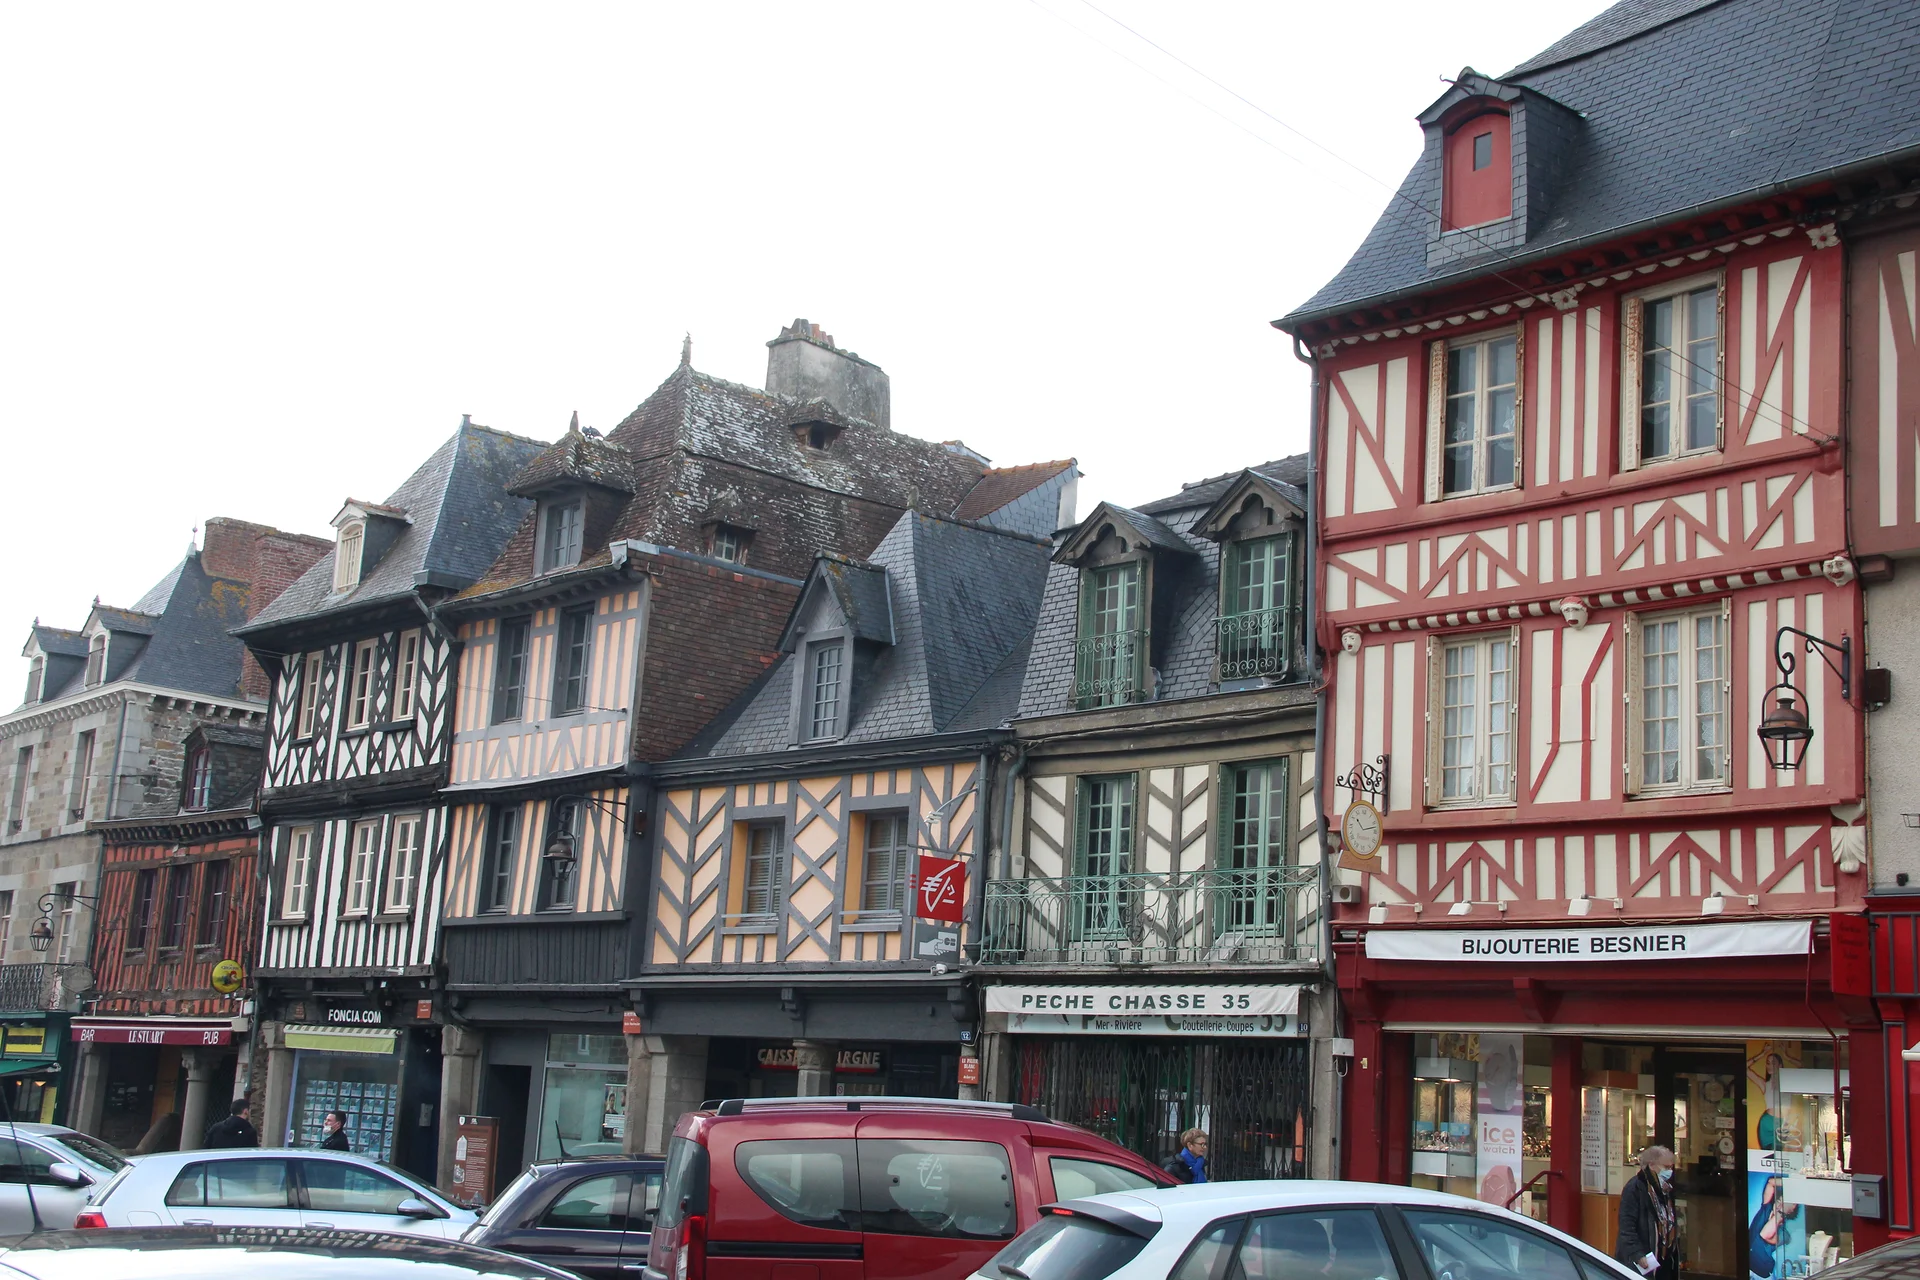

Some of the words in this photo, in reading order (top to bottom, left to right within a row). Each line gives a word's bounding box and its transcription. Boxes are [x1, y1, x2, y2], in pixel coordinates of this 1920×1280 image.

[1462, 938, 1579, 955] BIJOUTERIE
[1590, 934, 1686, 953] BESNIER
[1021, 994, 1094, 1009] PECHE
[1108, 994, 1206, 1010] CHASSE
[1222, 994, 1250, 1009] 35
[80, 1029, 95, 1042] BAR
[128, 1030, 138, 1043] LE
[138, 1030, 165, 1044] STUART
[203, 1031, 219, 1045] PUB
[1483, 1121, 1515, 1143] ice
[1484, 1146, 1515, 1154] watch
[1760, 1159, 1790, 1169] LOTUS
